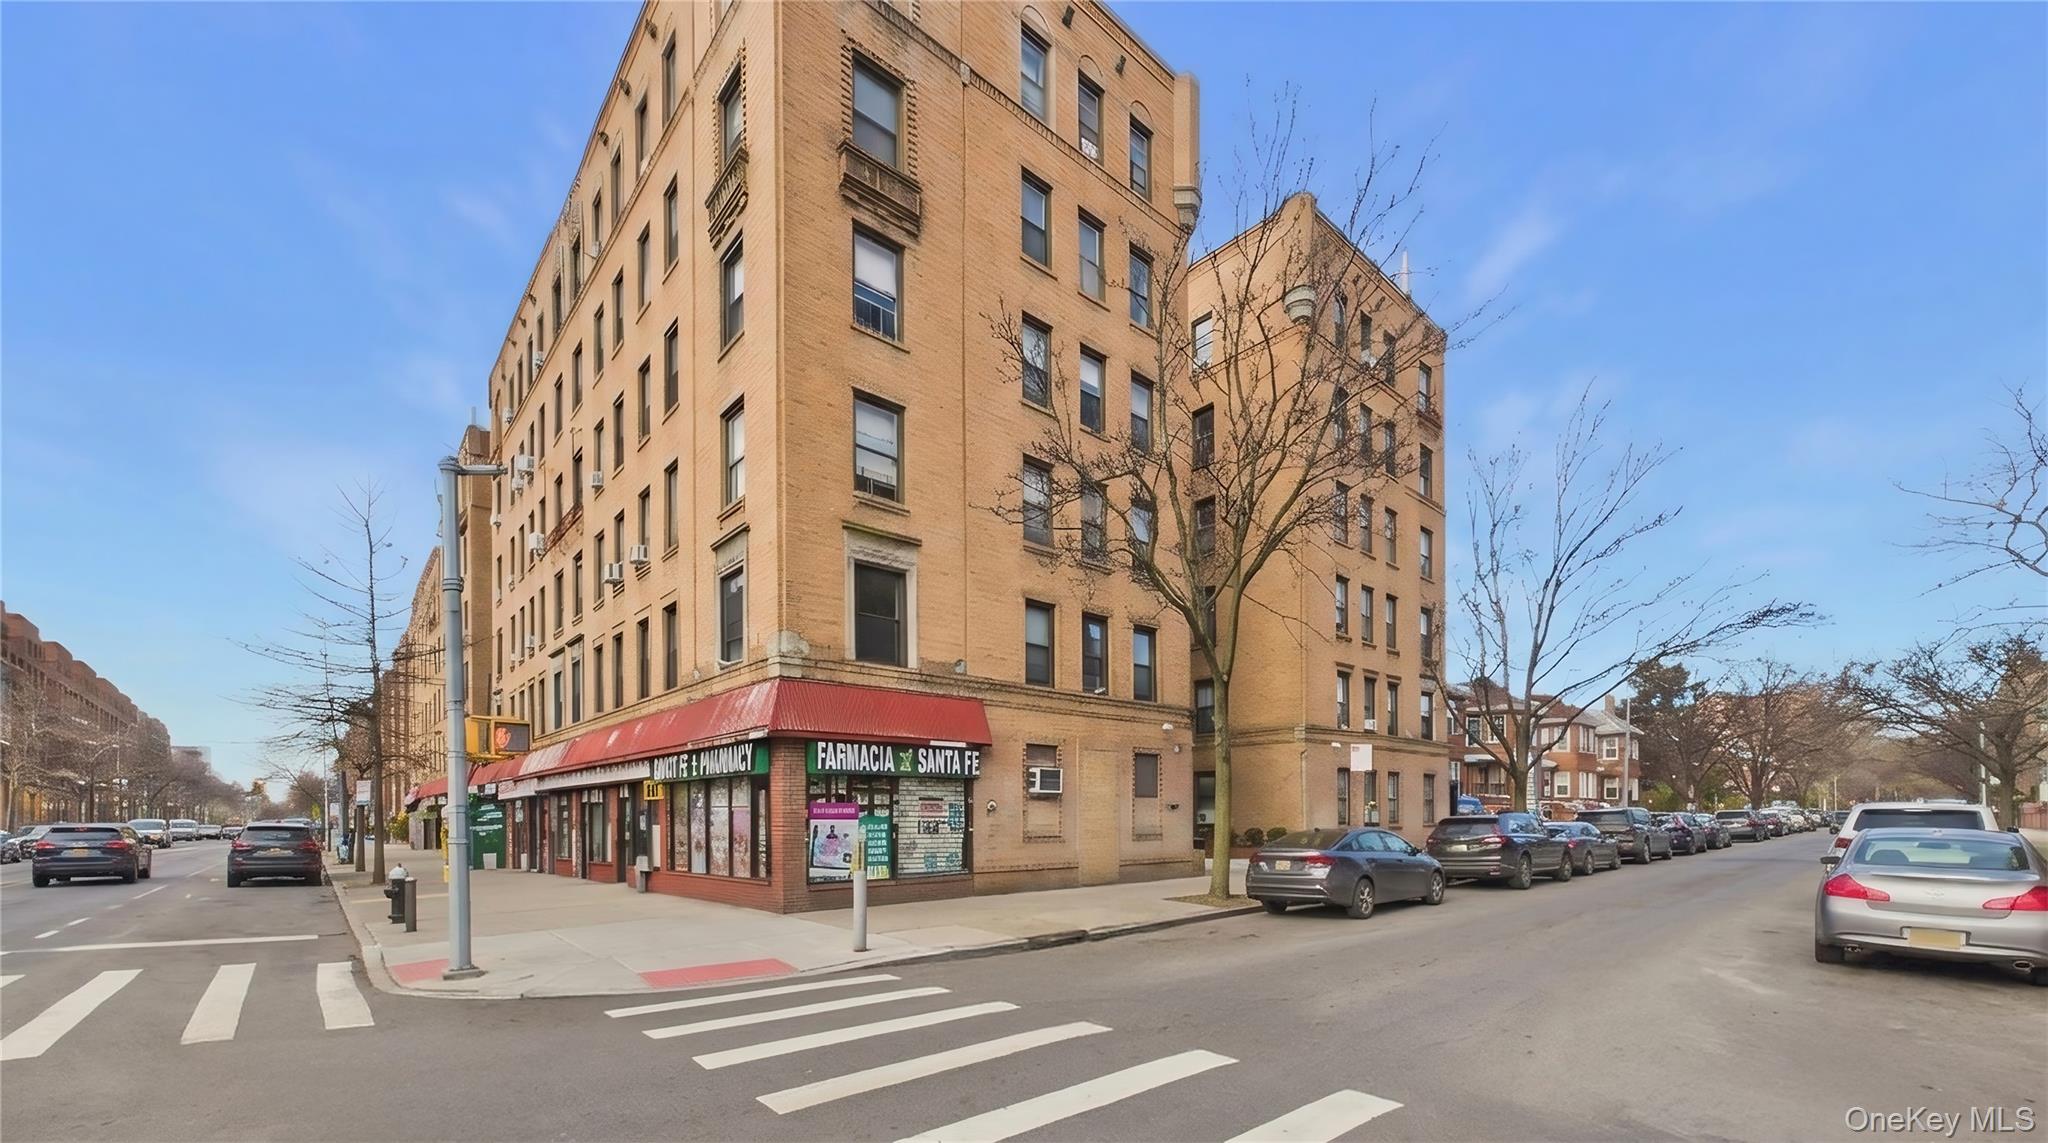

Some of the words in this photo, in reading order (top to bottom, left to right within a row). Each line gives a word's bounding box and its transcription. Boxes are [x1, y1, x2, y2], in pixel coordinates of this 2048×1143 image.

[817, 741, 895, 772] FARMACIA
[918, 748, 961, 774] SANTA
[965, 751, 980, 776] FE
